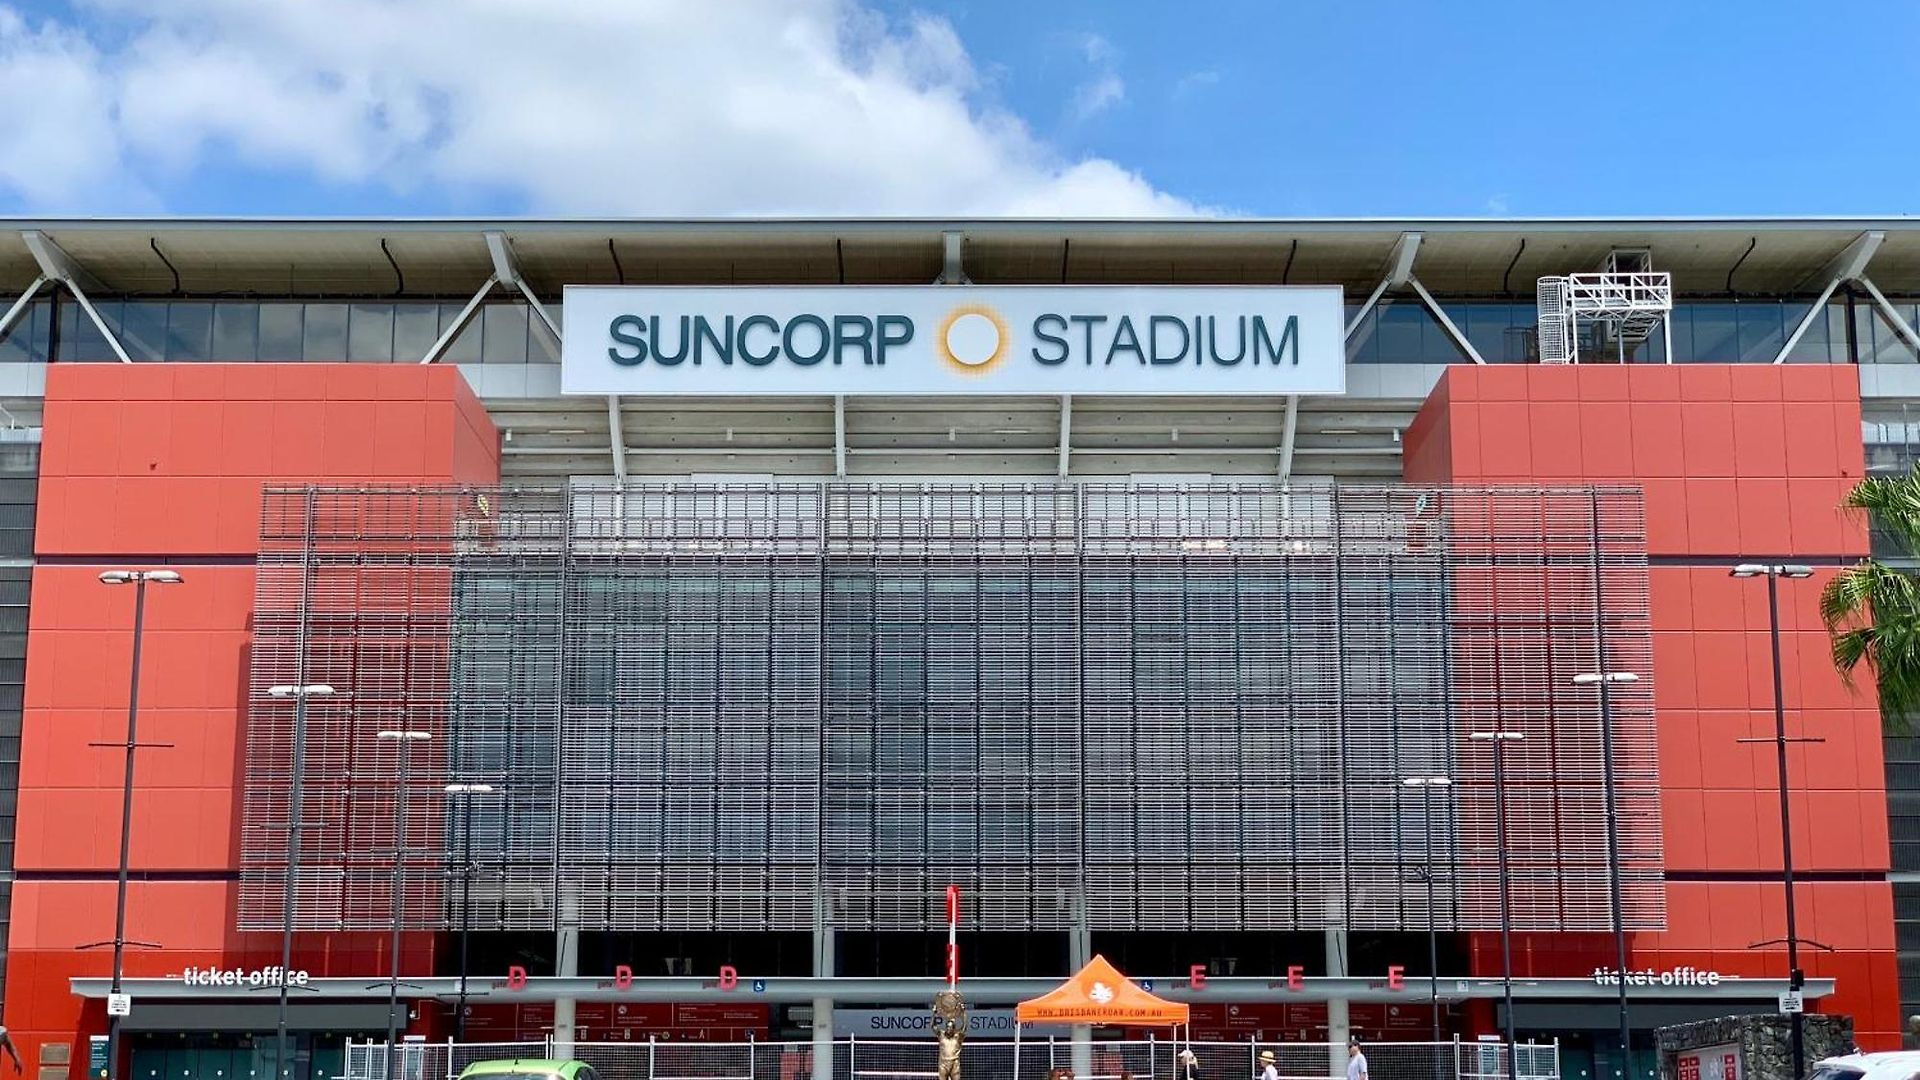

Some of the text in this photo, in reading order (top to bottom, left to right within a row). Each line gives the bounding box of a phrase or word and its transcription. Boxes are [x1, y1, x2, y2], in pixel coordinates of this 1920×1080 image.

[608, 313, 1299, 366] SUNCORP STADIUM
[183, 966, 309, 986] ticket office
[509, 965, 527, 991] D
[615, 965, 632, 991] D
[720, 965, 737, 991] D
[1190, 964, 1207, 991] E
[1287, 965, 1304, 991] E
[1388, 965, 1405, 991] E
[1594, 966, 1720, 986] ticket office
